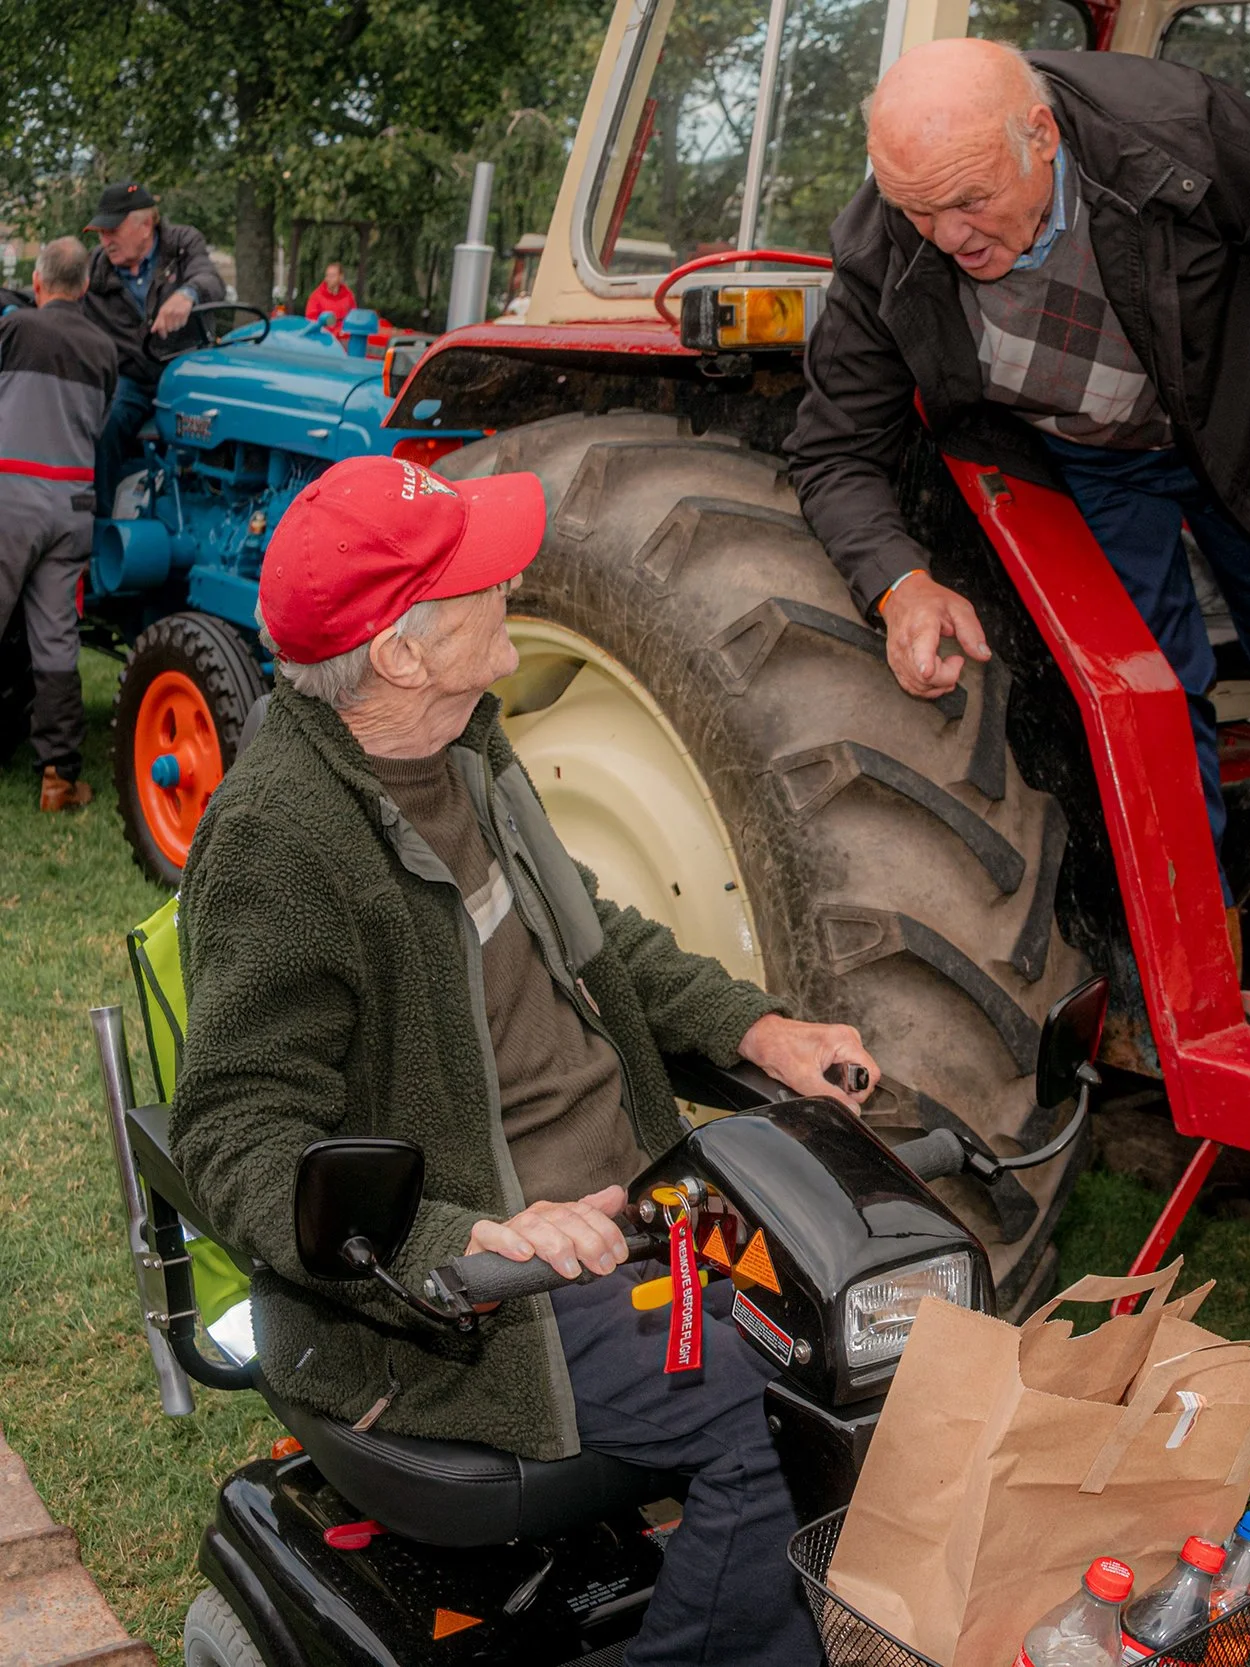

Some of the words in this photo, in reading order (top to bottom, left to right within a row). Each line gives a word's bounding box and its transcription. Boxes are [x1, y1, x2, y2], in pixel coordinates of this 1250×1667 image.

[678, 1239, 692, 1288] REMOVE
[681, 1288, 694, 1332] BEFORE
[678, 1331, 692, 1365] FLIGHT
